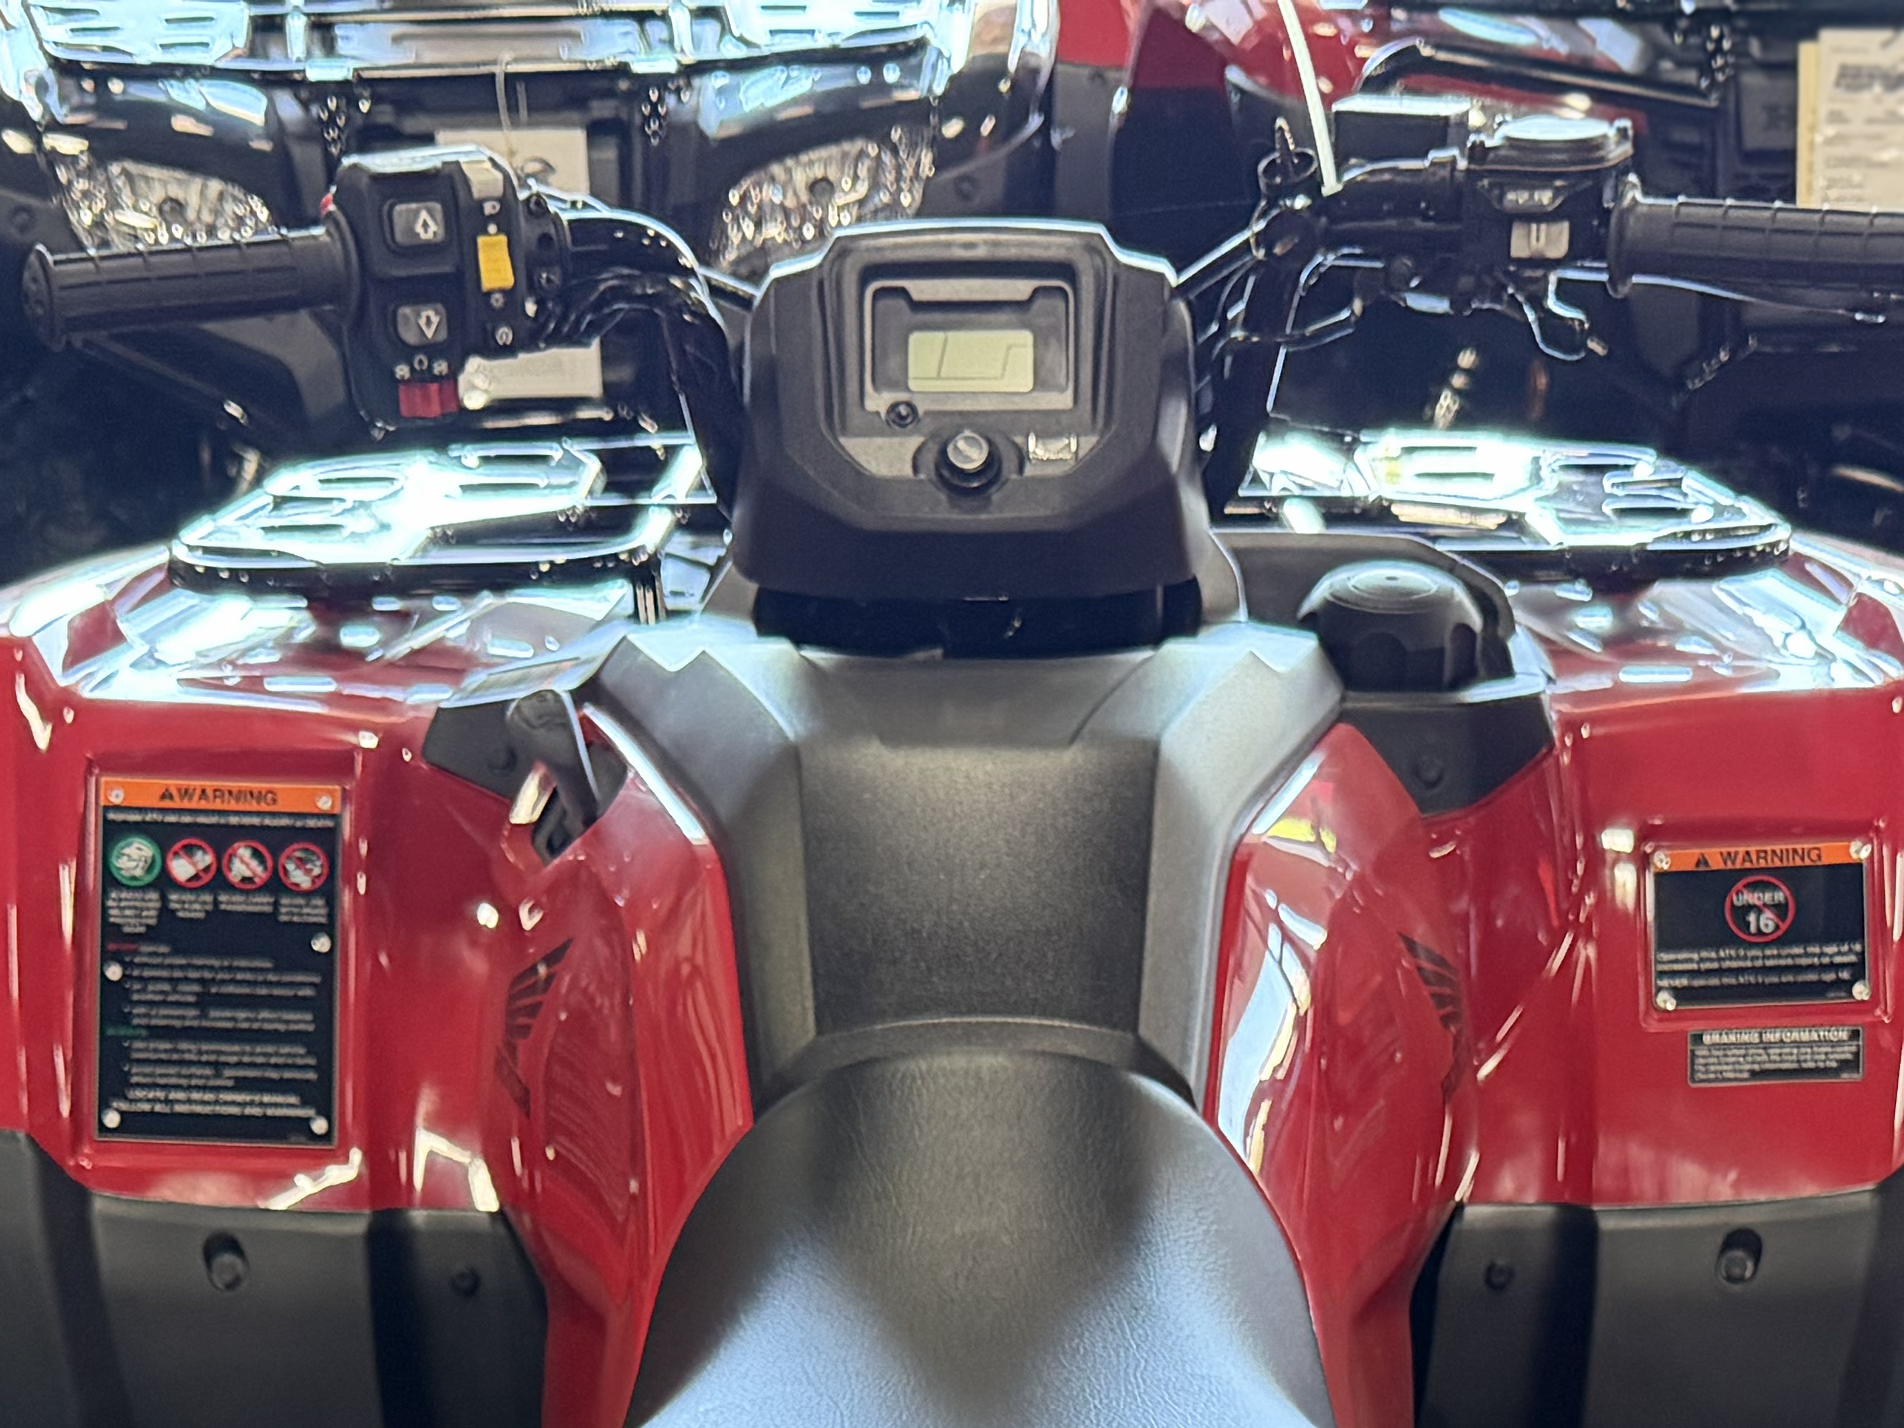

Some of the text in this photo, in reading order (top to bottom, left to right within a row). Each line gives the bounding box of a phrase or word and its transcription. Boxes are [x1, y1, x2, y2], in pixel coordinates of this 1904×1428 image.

[177, 788, 278, 806] WARNING
[1720, 847, 1822, 866] WARNING
[1733, 890, 1786, 907] UNDER
[1746, 909, 1776, 934] 16
